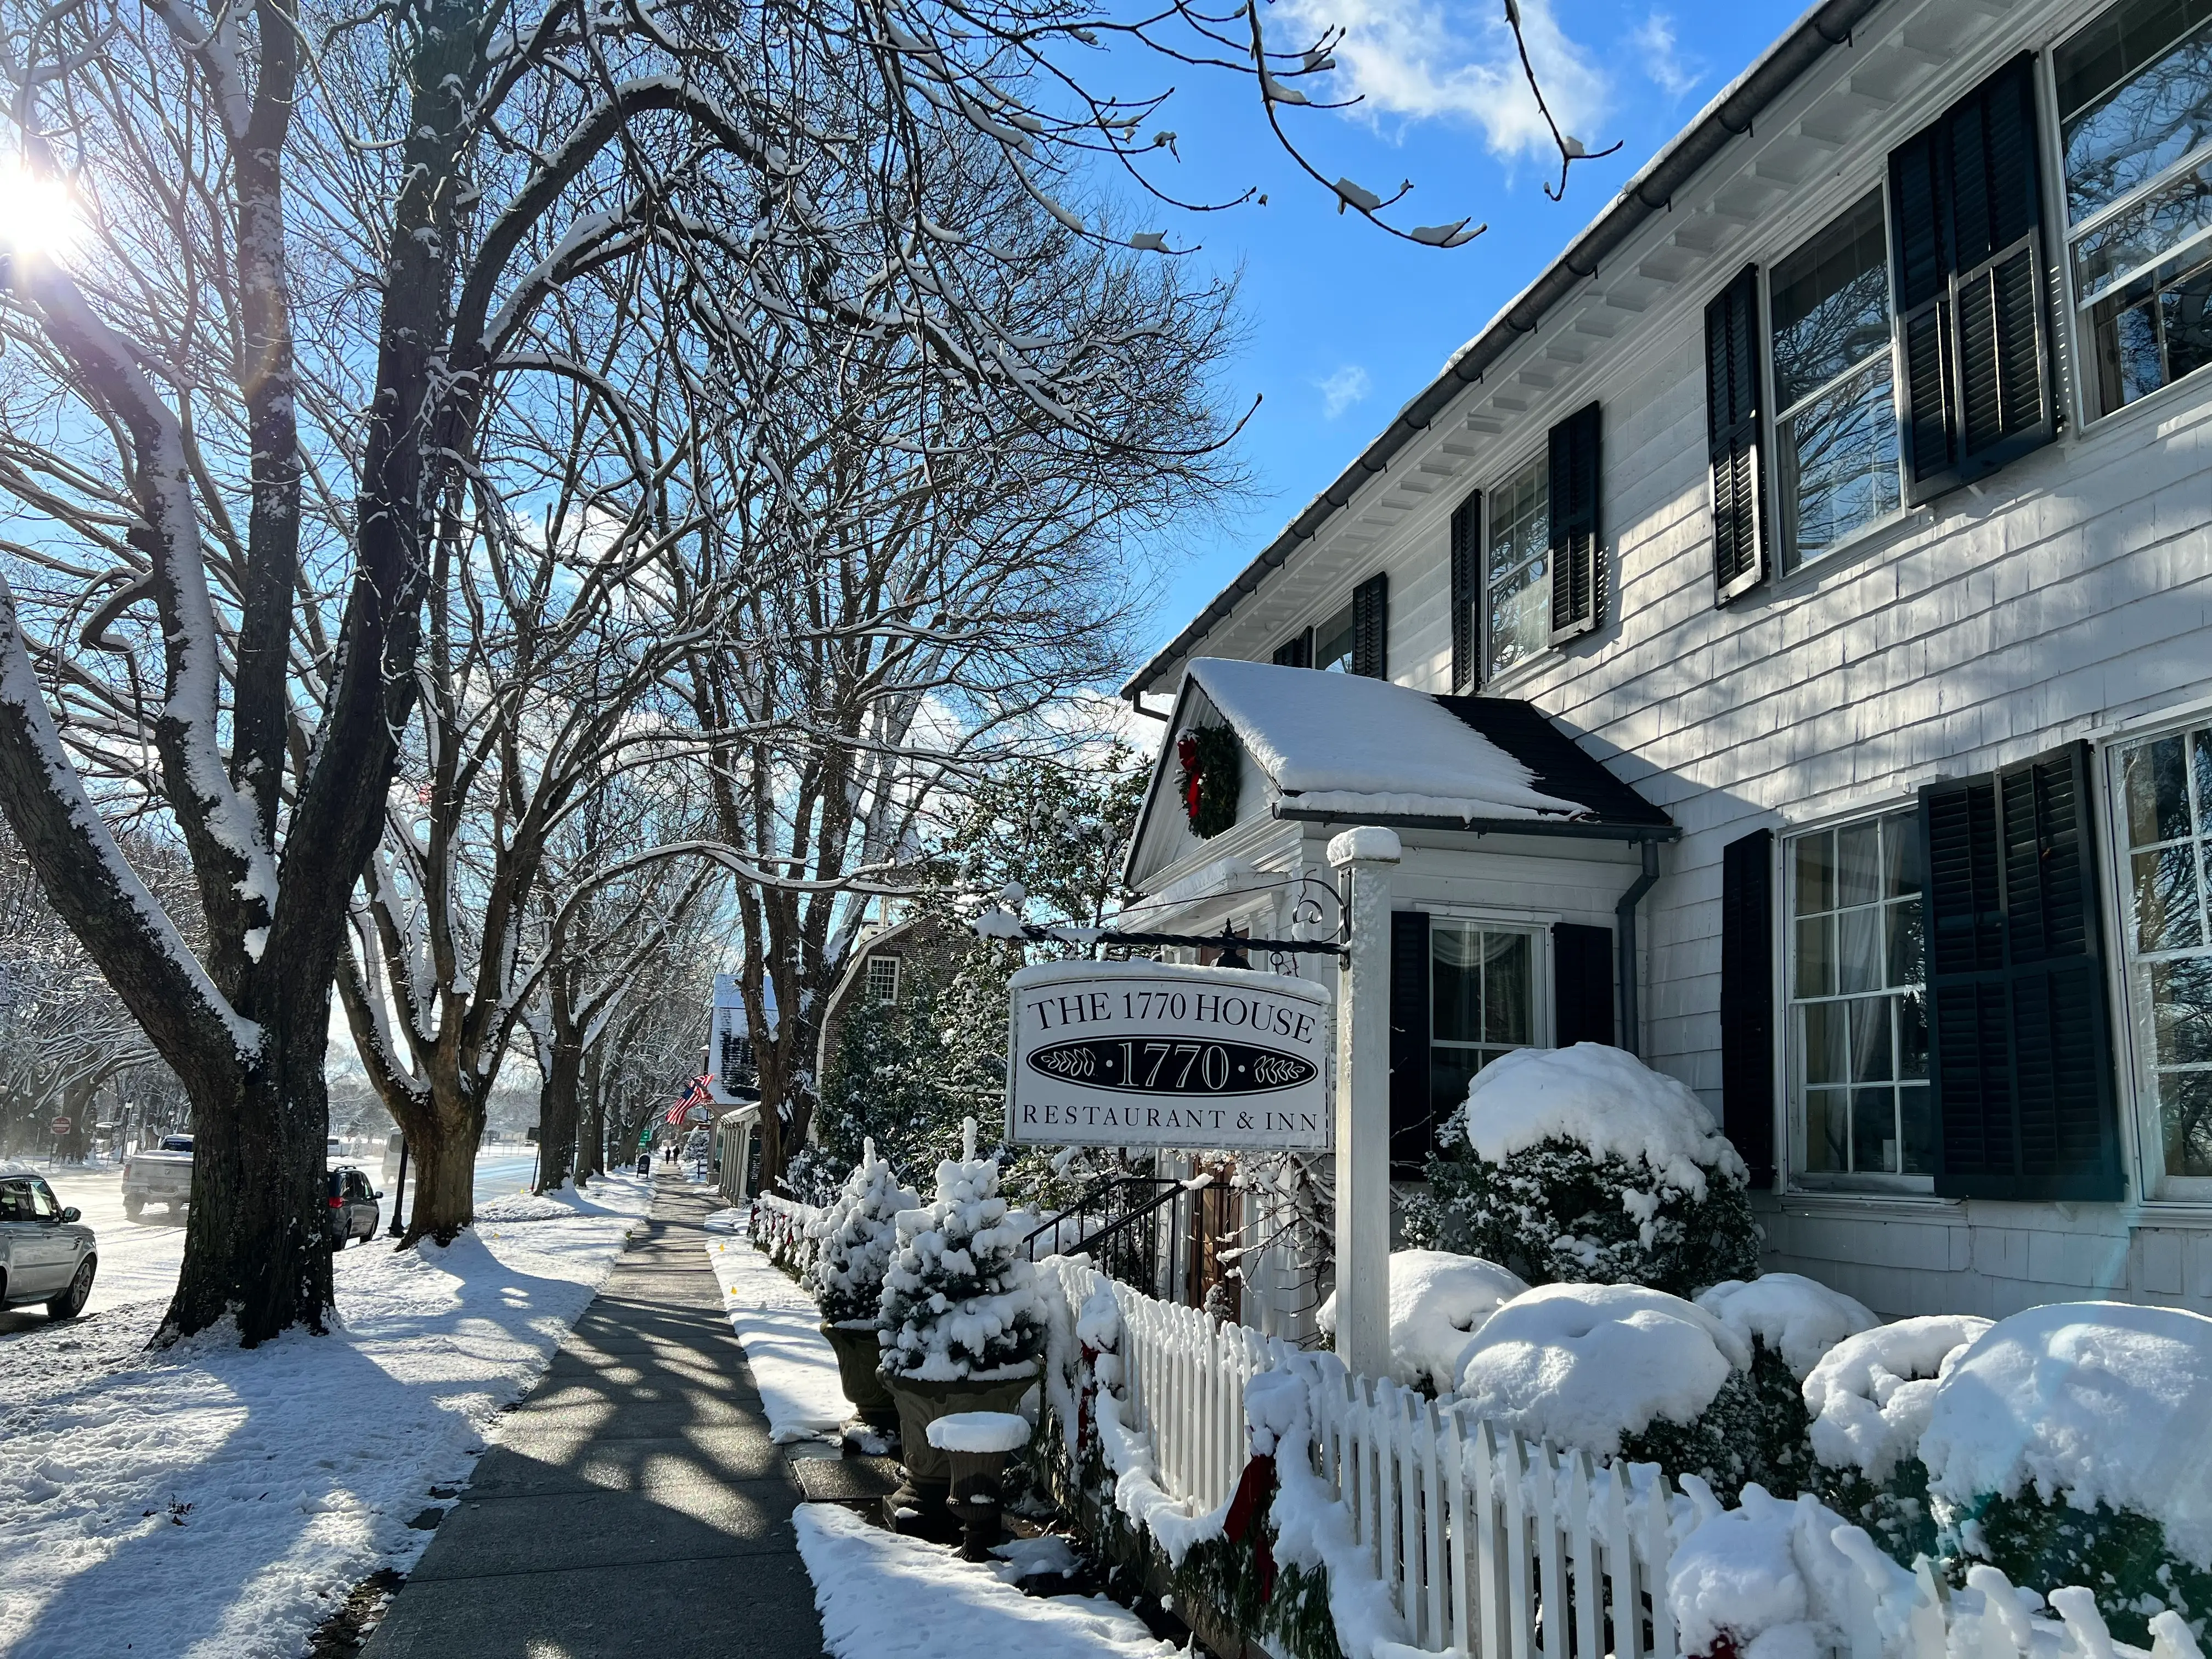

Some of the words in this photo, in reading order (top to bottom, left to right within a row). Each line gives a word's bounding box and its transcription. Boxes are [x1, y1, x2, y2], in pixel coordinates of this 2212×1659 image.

[1027, 992, 1111, 1030] THE
[1123, 991, 1186, 1019] 1770
[1194, 993, 1316, 1044] HOUSE
[1117, 1042, 1229, 1090] 1770
[1023, 1104, 1226, 1128] RESTAURANT
[1237, 1111, 1254, 1130] &
[1265, 1112, 1317, 1131] INN
